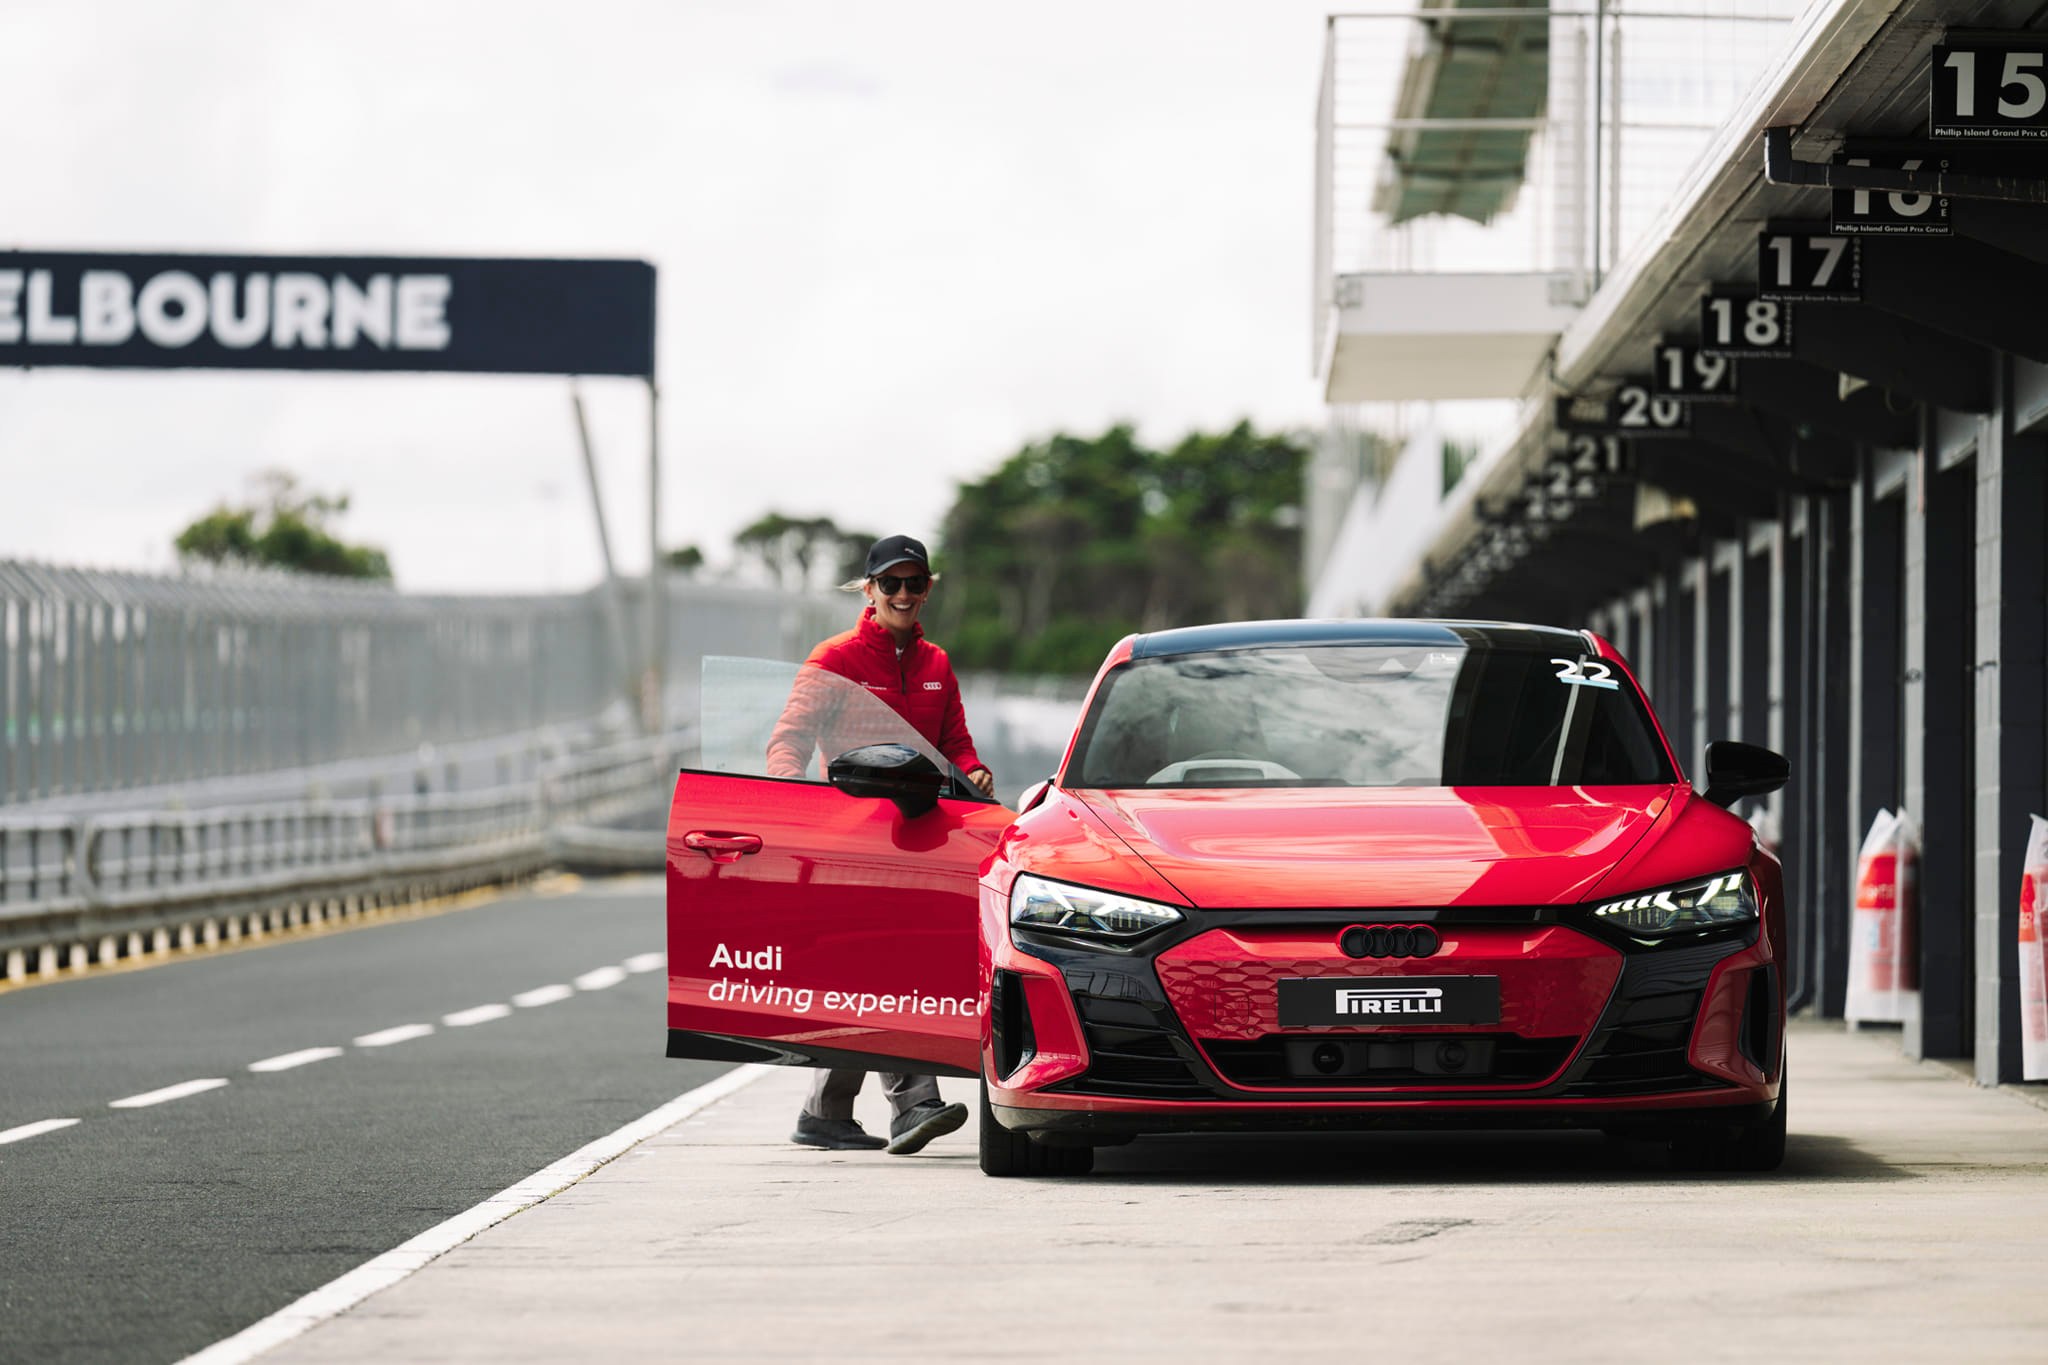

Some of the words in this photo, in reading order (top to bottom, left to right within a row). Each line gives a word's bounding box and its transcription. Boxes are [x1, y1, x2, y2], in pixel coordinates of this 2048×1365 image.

[1944, 51, 2047, 119] 15
[1935, 128, 1962, 137] Phillip
[1963, 129, 1990, 137] Island
[1991, 129, 2020, 137] Grand
[2021, 129, 2038, 137] Prix
[1835, 225, 1859, 233] Phillip
[1860, 225, 1883, 233] Island
[1884, 225, 1908, 233] Grand
[1768, 237, 1848, 287] 17
[1710, 299, 1781, 345] 18
[1663, 348, 1727, 389] 19
[1620, 386, 1681, 427] 20
[1573, 436, 1619, 472] 21
[1551, 659, 1619, 685] 22
[709, 943, 782, 970] Audi
[708, 977, 813, 1013] driving
[1335, 987, 1443, 1014] PIRELLI
